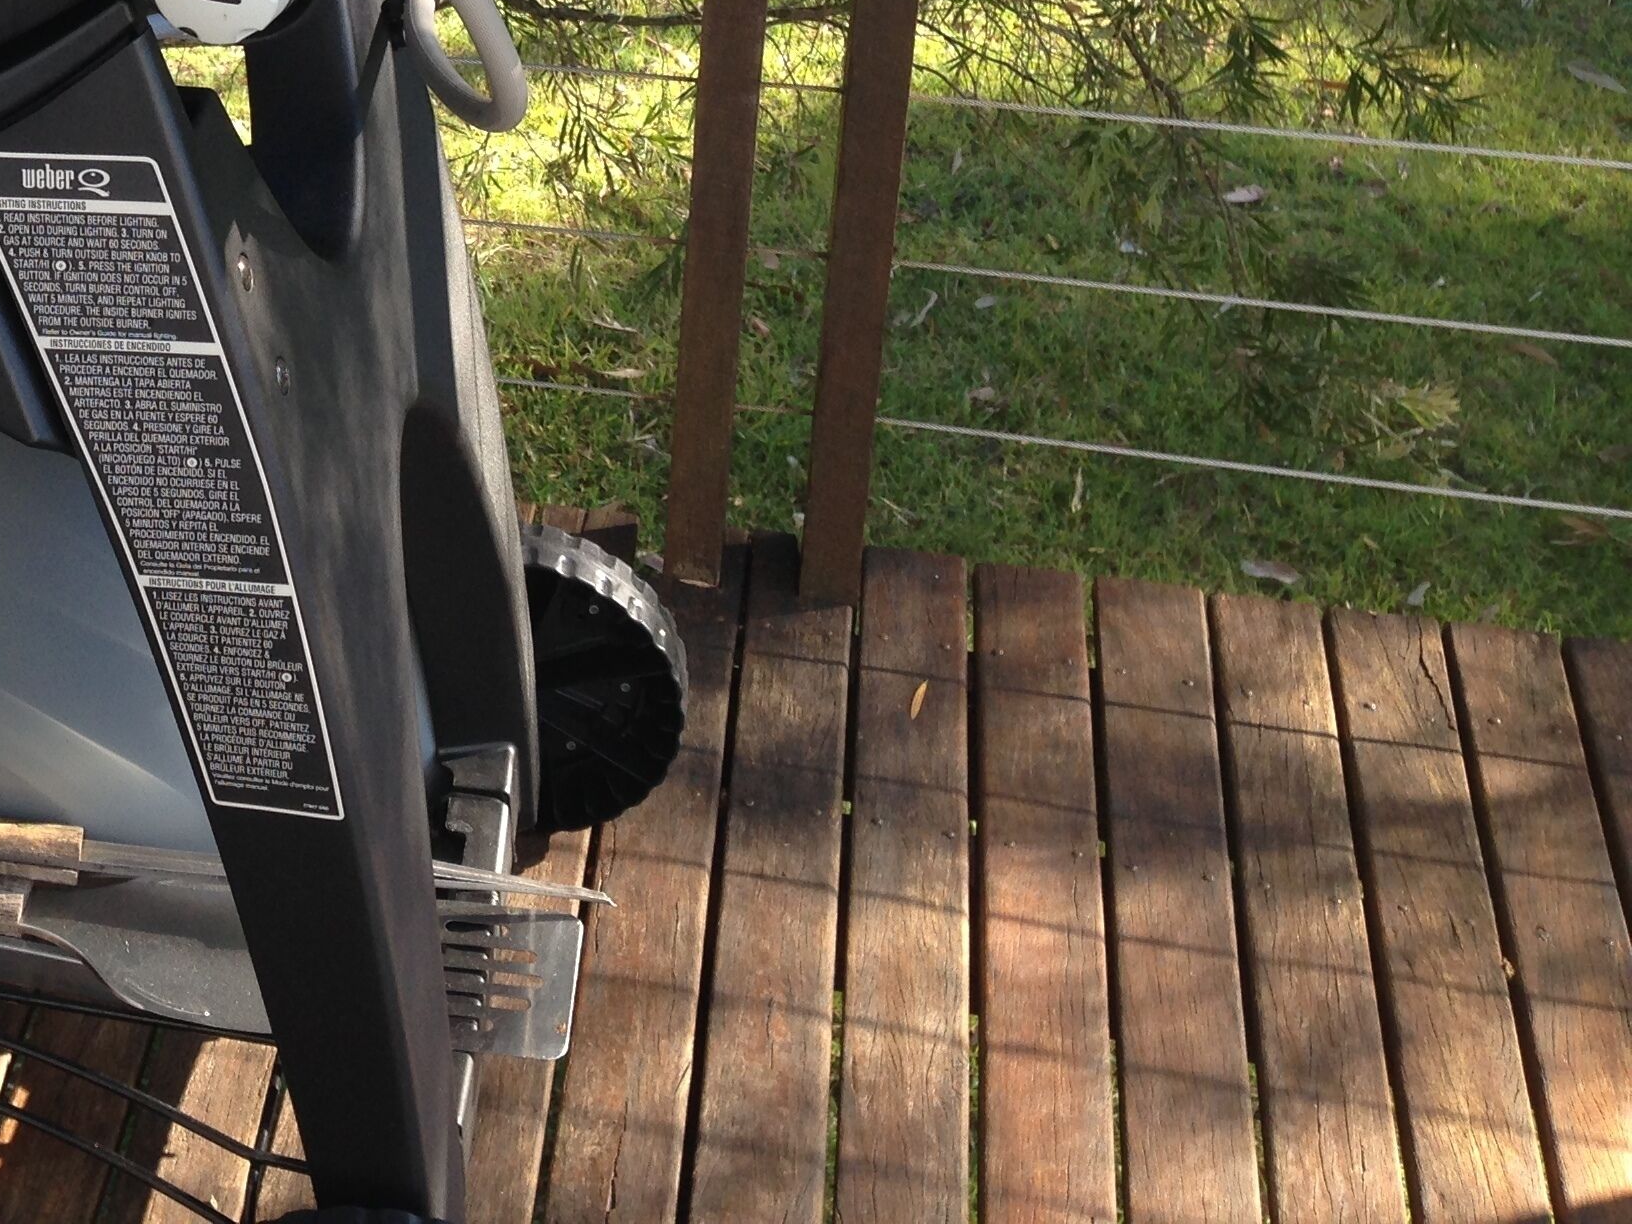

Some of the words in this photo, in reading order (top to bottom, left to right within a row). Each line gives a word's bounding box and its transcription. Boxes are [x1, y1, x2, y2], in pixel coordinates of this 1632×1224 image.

[21, 164, 75, 190] weber
[77, 168, 110, 197] Q
[28, 200, 87, 210] INSTRUCTIONS
[4, 213, 25, 223] READ
[27, 214, 86, 225] INSTRUCTIONS
[88, 216, 118, 225] BEFORE
[8, 225, 30, 234] OPEN
[32, 226, 45, 235] LID
[47, 226, 78, 236] DURING
[132, 229, 154, 238] TURN
[156, 230, 168, 239] ON
[4, 236, 20, 245] GAS
[22, 236, 32, 246] AT
[34, 237, 67, 247] SOURCE
[68, 238, 85, 247] AND
[87, 238, 107, 248] WAIT
[109, 239, 120, 248] 60
[19, 248, 41, 258] PUSH
[52, 249, 73, 259] TURN
[75, 250, 110, 260] OUTSIDE
[111, 251, 144, 261] BURNER
[146, 252, 168, 262] KNOB
[170, 253, 181, 262] TO
[89, 262, 116, 271] PRESS
[117, 262, 133, 272] THE
[134, 263, 171, 273] IGNITION
[55, 272, 63, 282] IF
[64, 273, 99, 283] IGNITION
[101, 274, 123, 284] DOES
[124, 275, 141, 284] NOT
[142, 275, 170, 285] OCCUR
[172, 276, 181, 286] IN
[65, 284, 87, 294] TURN
[89, 285, 122, 295] BURNER
[124, 286, 160, 296] CONTROL
[29, 294, 50, 303] WAIT
[97, 296, 115, 306] AND
[117, 297, 147, 307] REPEAT
[149, 298, 186, 308] LIGHTING
[86, 307, 101, 316] THE
[103, 307, 129, 317] INSIDE
[131, 308, 164, 318] BURNER
[166, 310, 197, 320] IGNITES
[39, 316, 62, 326] FROM
[63, 317, 79, 327] THE
[81, 318, 115, 328] OUTSIDE
[51, 339, 113, 350] INSTRUCCIONES
[115, 341, 125, 350] DE
[127, 341, 171, 351] ENCENDIDO
[65, 354, 80, 363] LEA
[82, 354, 98, 364] LAS
[100, 355, 165, 366] INSTRUCCIONES
[166, 357, 193, 367] ANTES
[195, 358, 206, 368] DE
[60, 365, 103, 376] PROCEDER
[113, 367, 156, 378] ENCENDER
[75, 377, 120, 387] MANTENGA
[158, 379, 192, 390] ABIERTA
[70, 388, 112, 398] MIENTRAS
[135, 390, 192, 401] ENCENDIENDO
[171, 402, 223, 413] SUMINISTRO
[136, 412, 166, 422] FUENTE
[176, 413, 206, 423] ESPERE
[143, 423, 184, 433] PRESIONE
[89, 431, 122, 442] PERILLA
[142, 433, 188, 444] QUEMADOR
[190, 435, 230, 446] EXTERIOR
[215, 459, 242, 469] PULSE
[108, 476, 155, 487] ENCENDIDO
[170, 478, 216, 489] OCURRIESE
[113, 487, 140, 497] LAPSO
[117, 497, 155, 508] CONTROL
[174, 500, 220, 510] QUEMADOR
[231, 512, 263, 522] ESPERE
[132, 519, 170, 530] MINUTOS
[179, 521, 208, 532] REPITA
[130, 530, 195, 541] PROCEDIMIENTO
[134, 540, 180, 551] QUEMADOR
[182, 542, 216, 552] INTERNO
[231, 544, 271, 555] ENCIENDE
[155, 551, 201, 562] QUEMADOR
[149, 578, 204, 590] INSTRUCTIONS
[205, 581, 228, 591] POUR
[229, 582, 276, 593] L'ALLUMAGE
[162, 591, 183, 601] LISEZ
[200, 594, 257, 606] INSTRUCTIONS
[258, 597, 285, 607] AVANT
[156, 601, 200, 613] D'ALLUMER
[259, 607, 291, 618] OUVREZ
[171, 612, 215, 624] COUVERCLE
[217, 615, 242, 626] AVANT
[244, 617, 289, 629] D'ALLUMER
[220, 626, 251, 636] OUVREZ
[178, 633, 209, 644] SOURCE
[221, 636, 262, 648] PATIENTEZ
[223, 646, 263, 658] ENFONCEZ
[173, 652, 208, 664] TOURNEZ
[221, 656, 253, 667] BOUTON
[190, 673, 224, 685] APPUYEZ
[255, 678, 287, 690] BOUTON
[198, 693, 232, 705] PRODUIT
[245, 688, 293, 700] L'ALLUMAGE
[190, 703, 225, 715] TOURNEZ
[238, 707, 283, 720] COMMANDE
[203, 723, 237, 736] MINUTES
[259, 729, 317, 743] RECOMMENCEZ
[270, 720, 311, 733] PATIENTEZ
